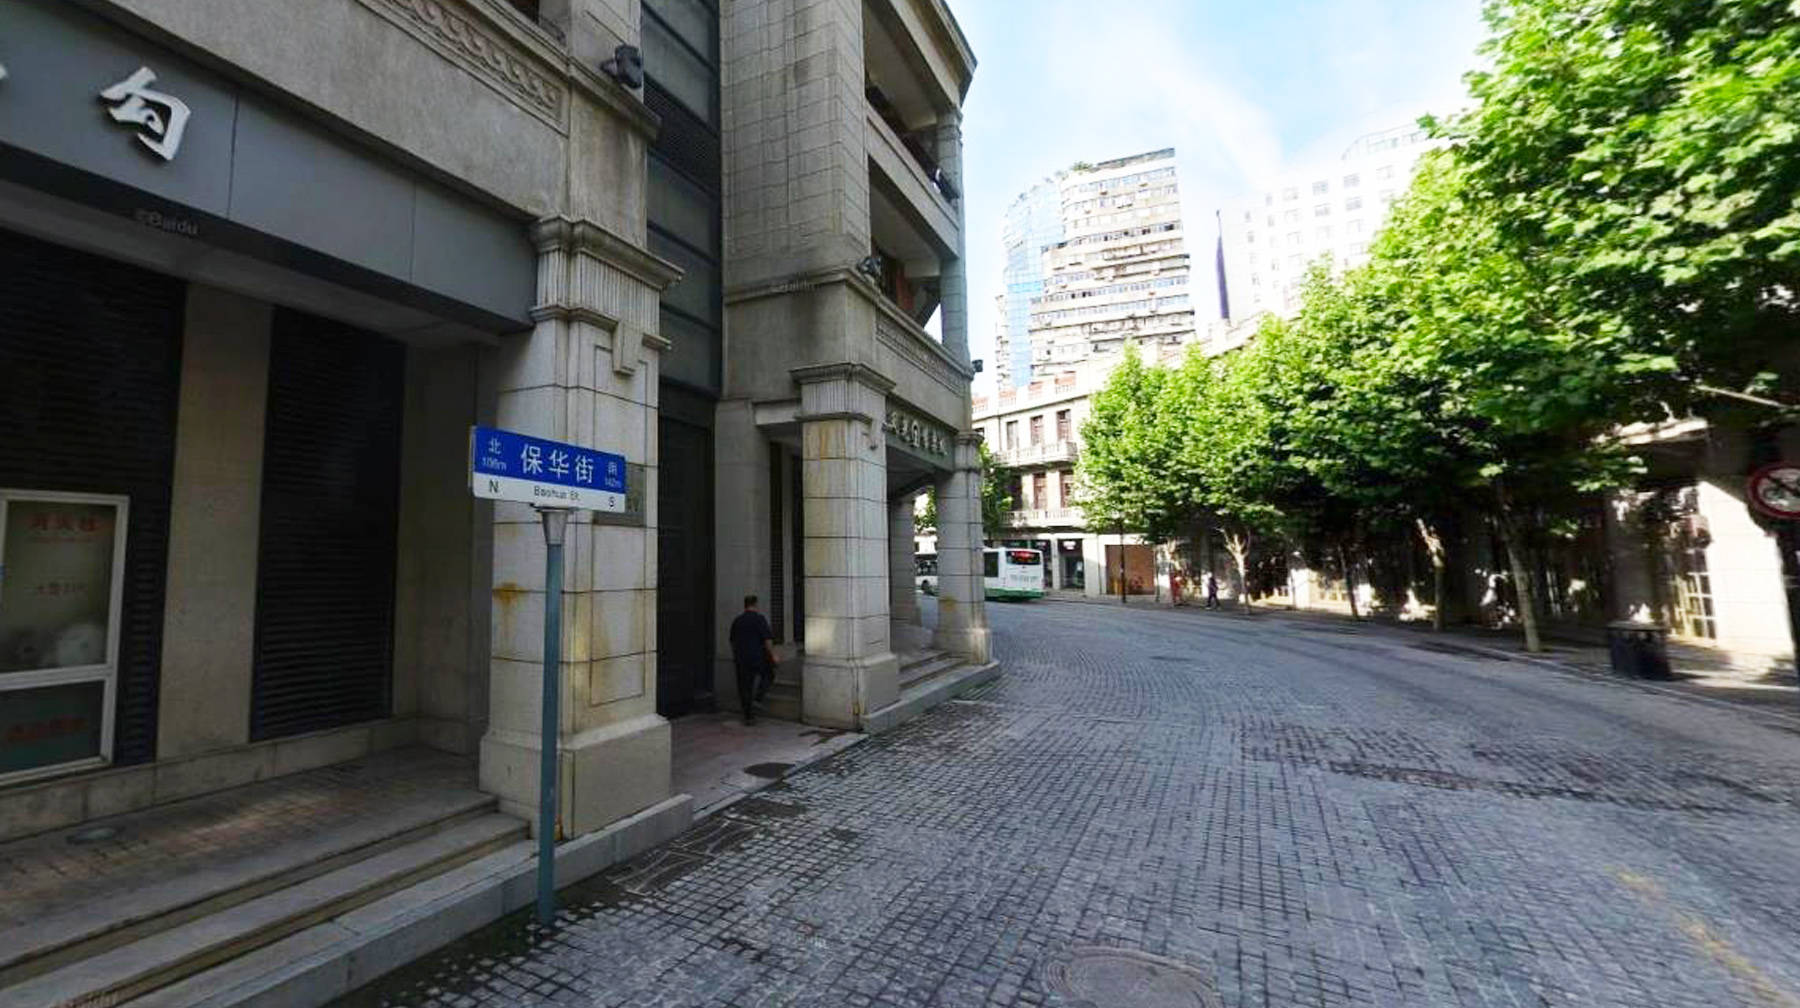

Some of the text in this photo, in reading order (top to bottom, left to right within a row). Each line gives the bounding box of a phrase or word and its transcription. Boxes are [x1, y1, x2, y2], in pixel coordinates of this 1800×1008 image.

[488, 437, 502, 455] 北
[520, 443, 594, 484] 保华街
[607, 461, 618, 477] 南
[488, 479, 499, 494] N
[608, 495, 616, 508] S
